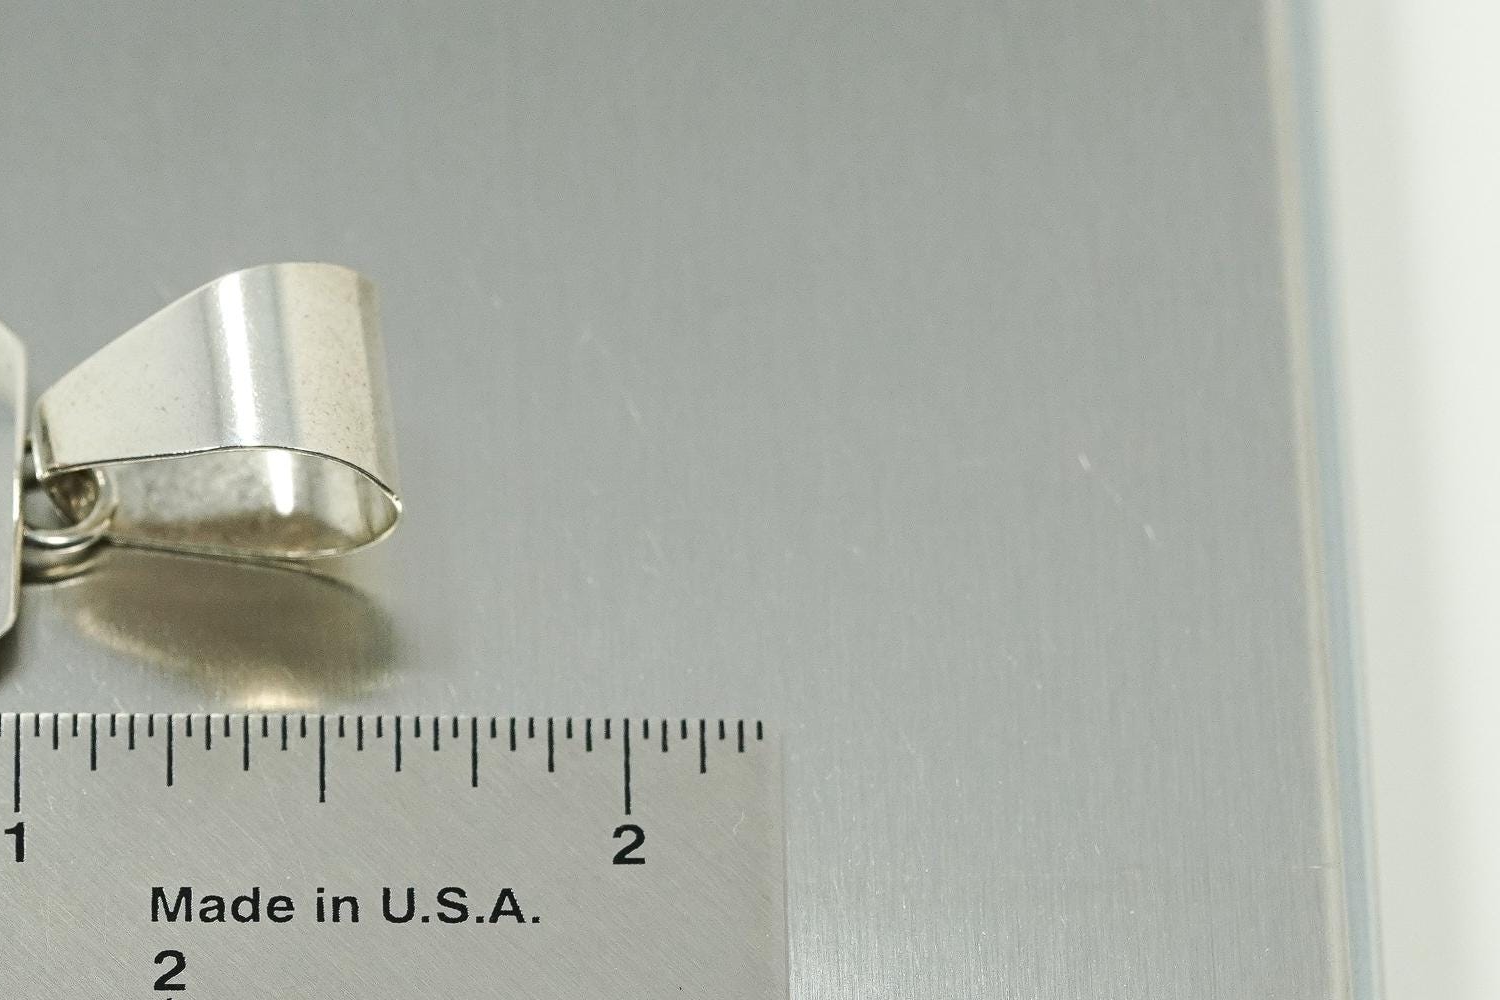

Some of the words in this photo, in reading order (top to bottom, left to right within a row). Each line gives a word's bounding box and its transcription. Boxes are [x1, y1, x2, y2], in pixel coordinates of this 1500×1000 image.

[3, 821, 26, 863] 1
[611, 823, 647, 866] 2
[150, 885, 296, 924] Made
[315, 885, 361, 924] in
[381, 886, 542, 925] U.S.A.
[153, 949, 188, 992] 2
